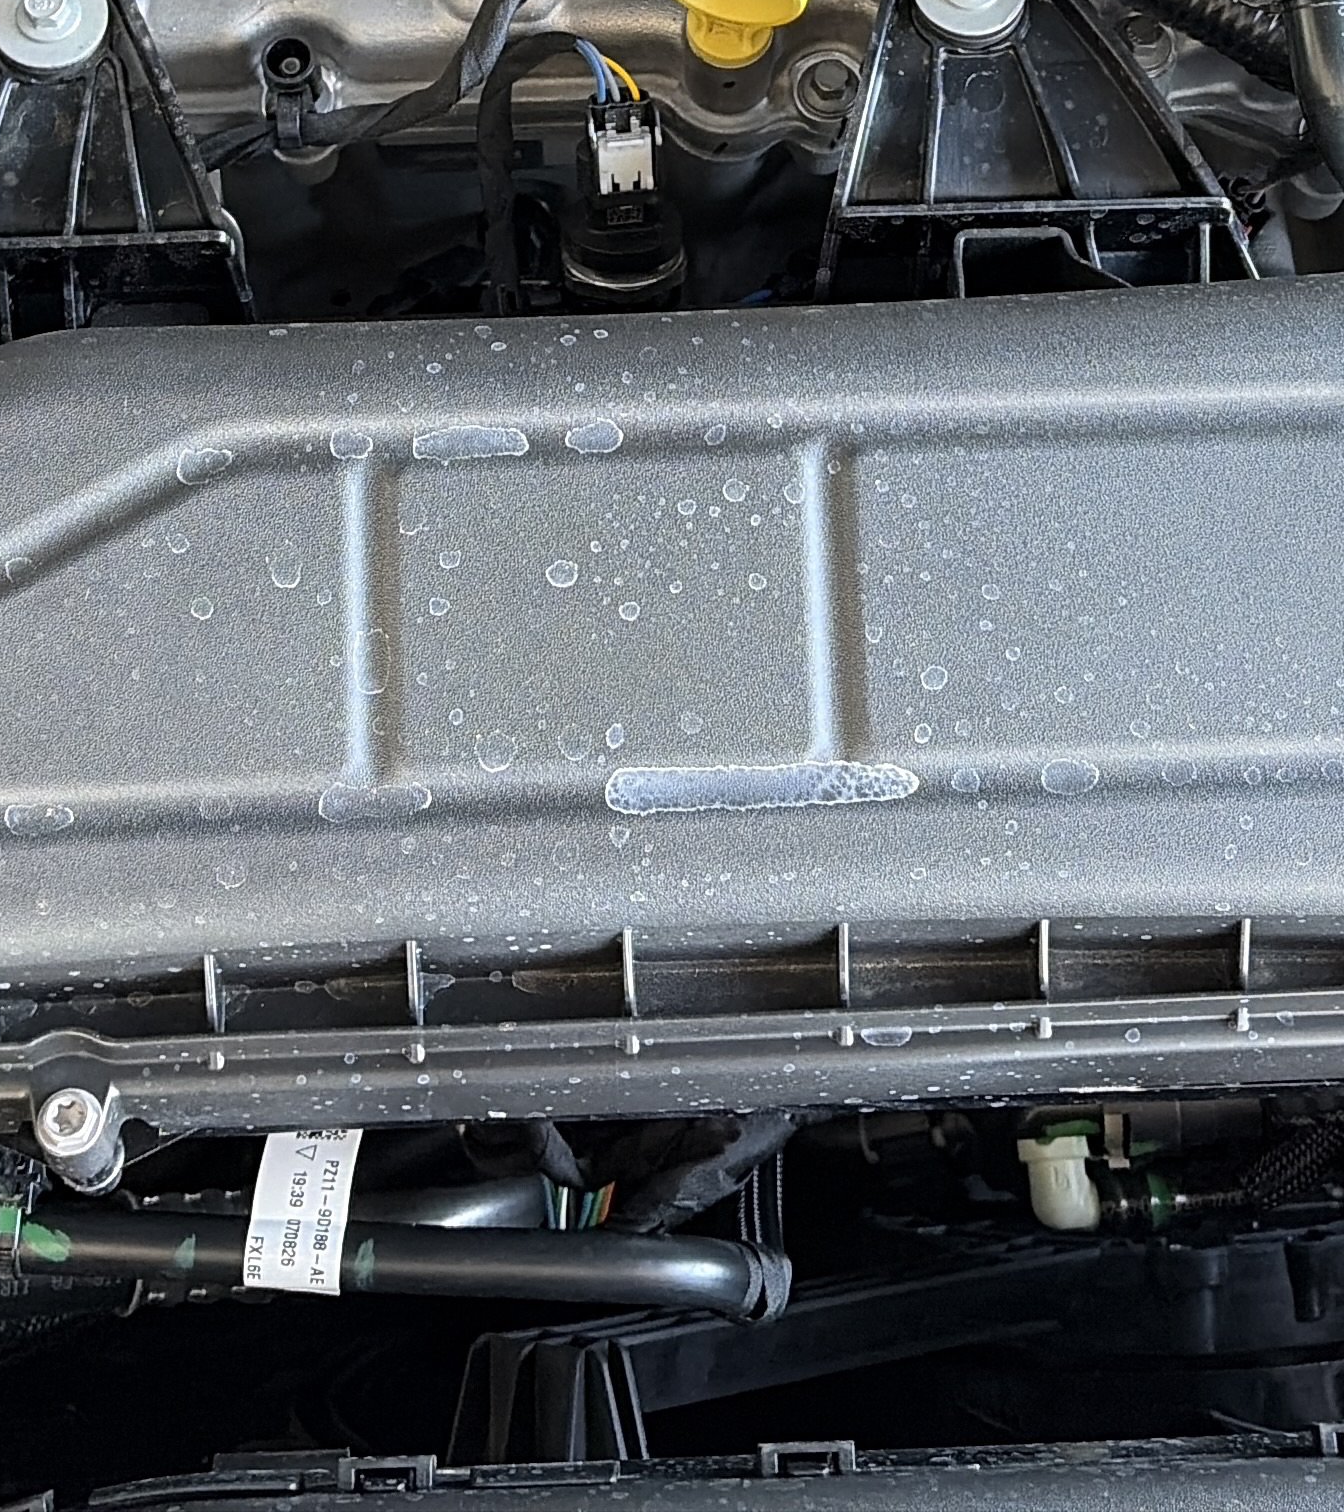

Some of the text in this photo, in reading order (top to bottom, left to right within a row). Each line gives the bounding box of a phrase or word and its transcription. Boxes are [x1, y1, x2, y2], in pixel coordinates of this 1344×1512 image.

[247, 1236, 264, 1281] FXL6E
[281, 1170, 307, 1267] 19:39 070826
[309, 1159, 340, 1285] PZ11-9D188-AE
